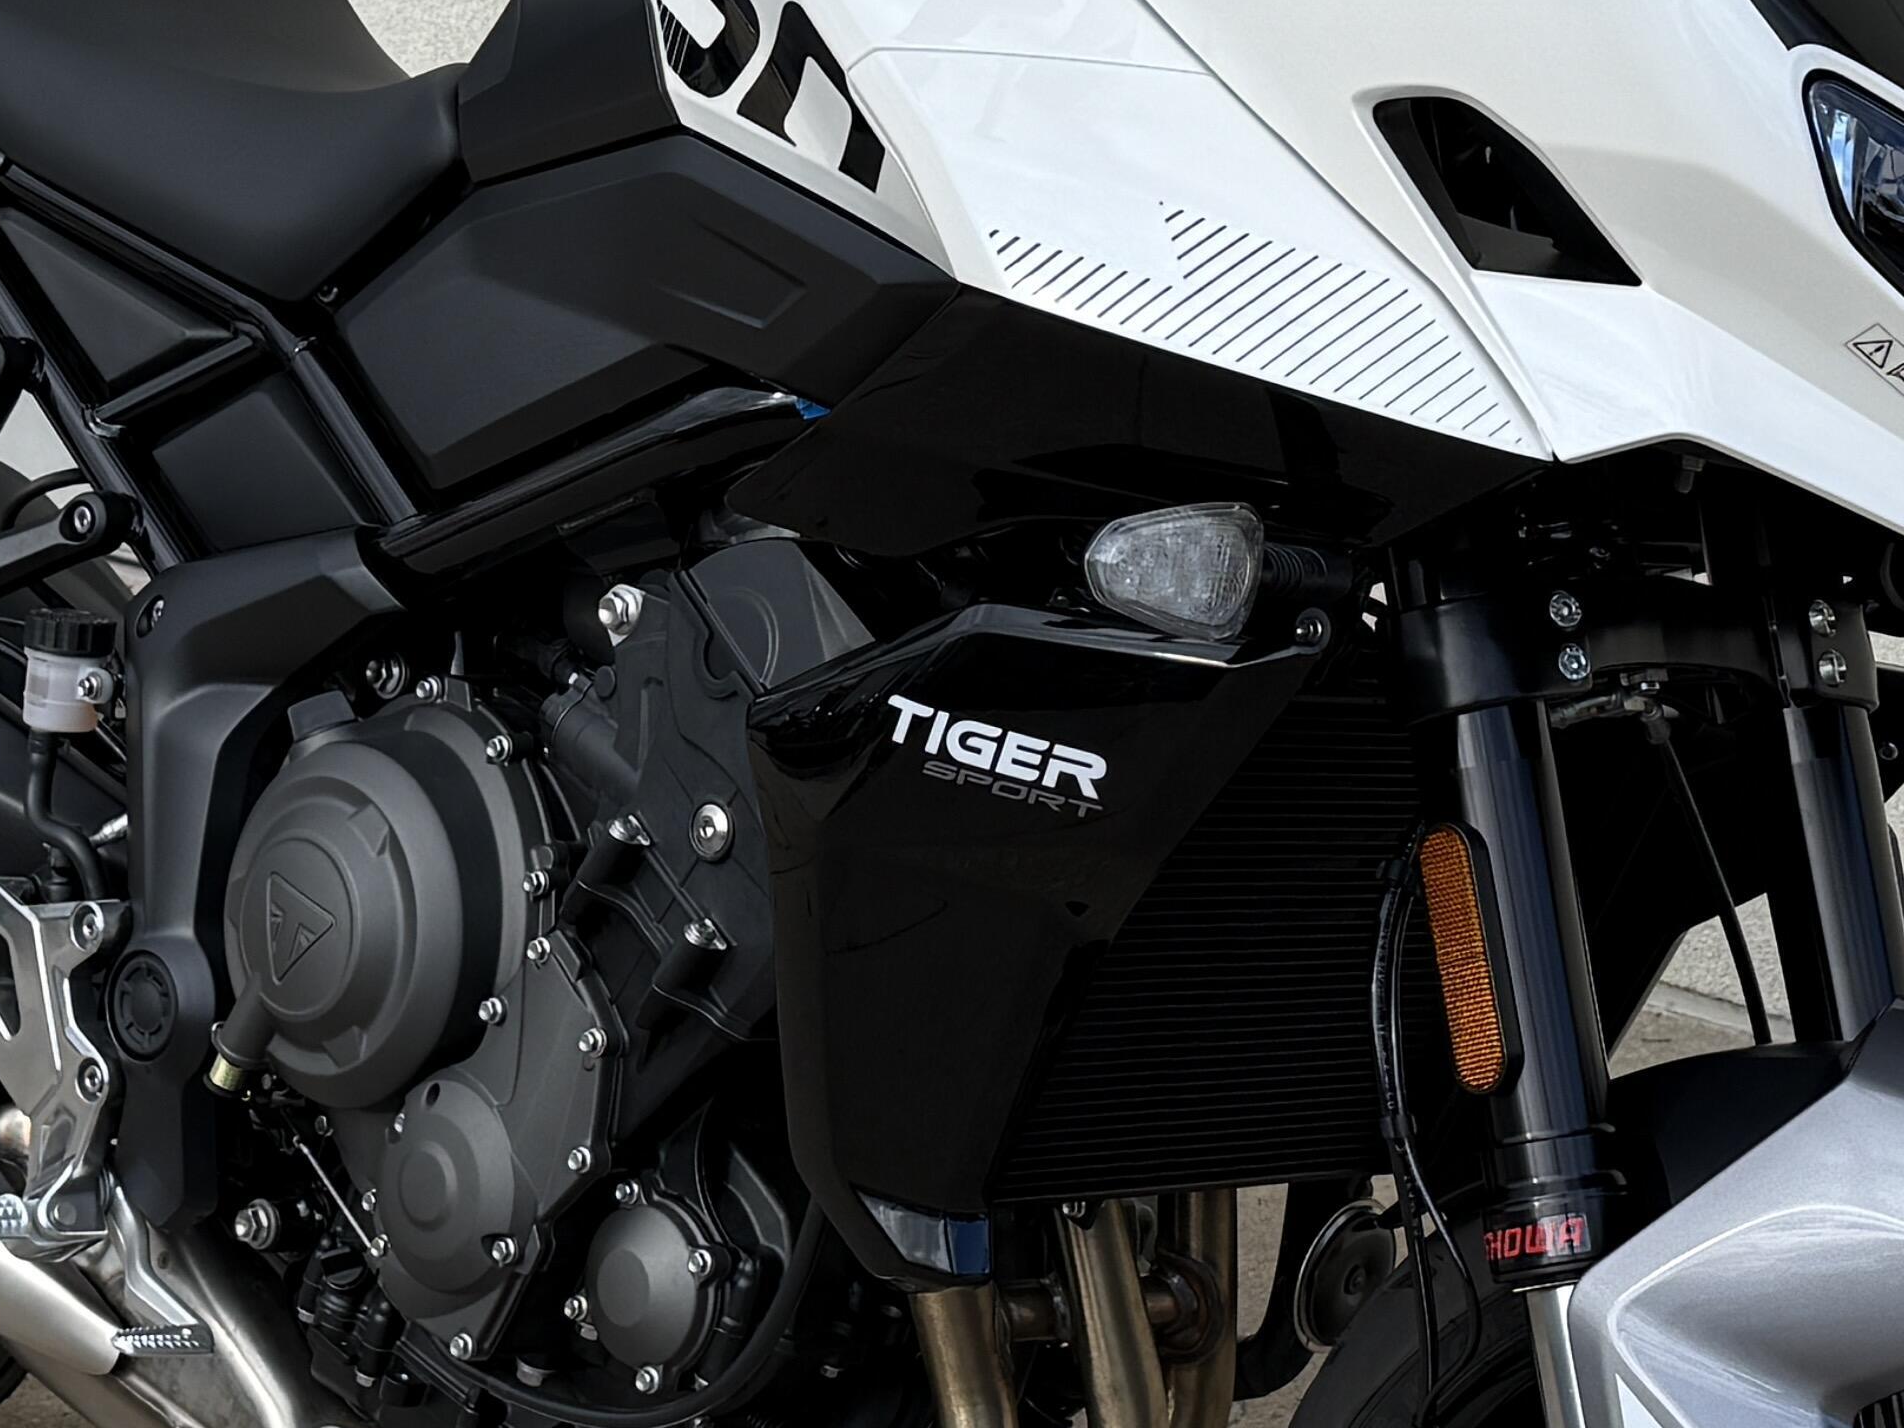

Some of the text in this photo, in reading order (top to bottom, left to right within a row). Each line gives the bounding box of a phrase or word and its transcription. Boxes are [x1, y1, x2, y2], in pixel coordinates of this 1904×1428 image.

[887, 693, 1108, 801] TIGER
[922, 759, 1104, 818] SPORT
[1483, 1215, 1586, 1262] HOWA
